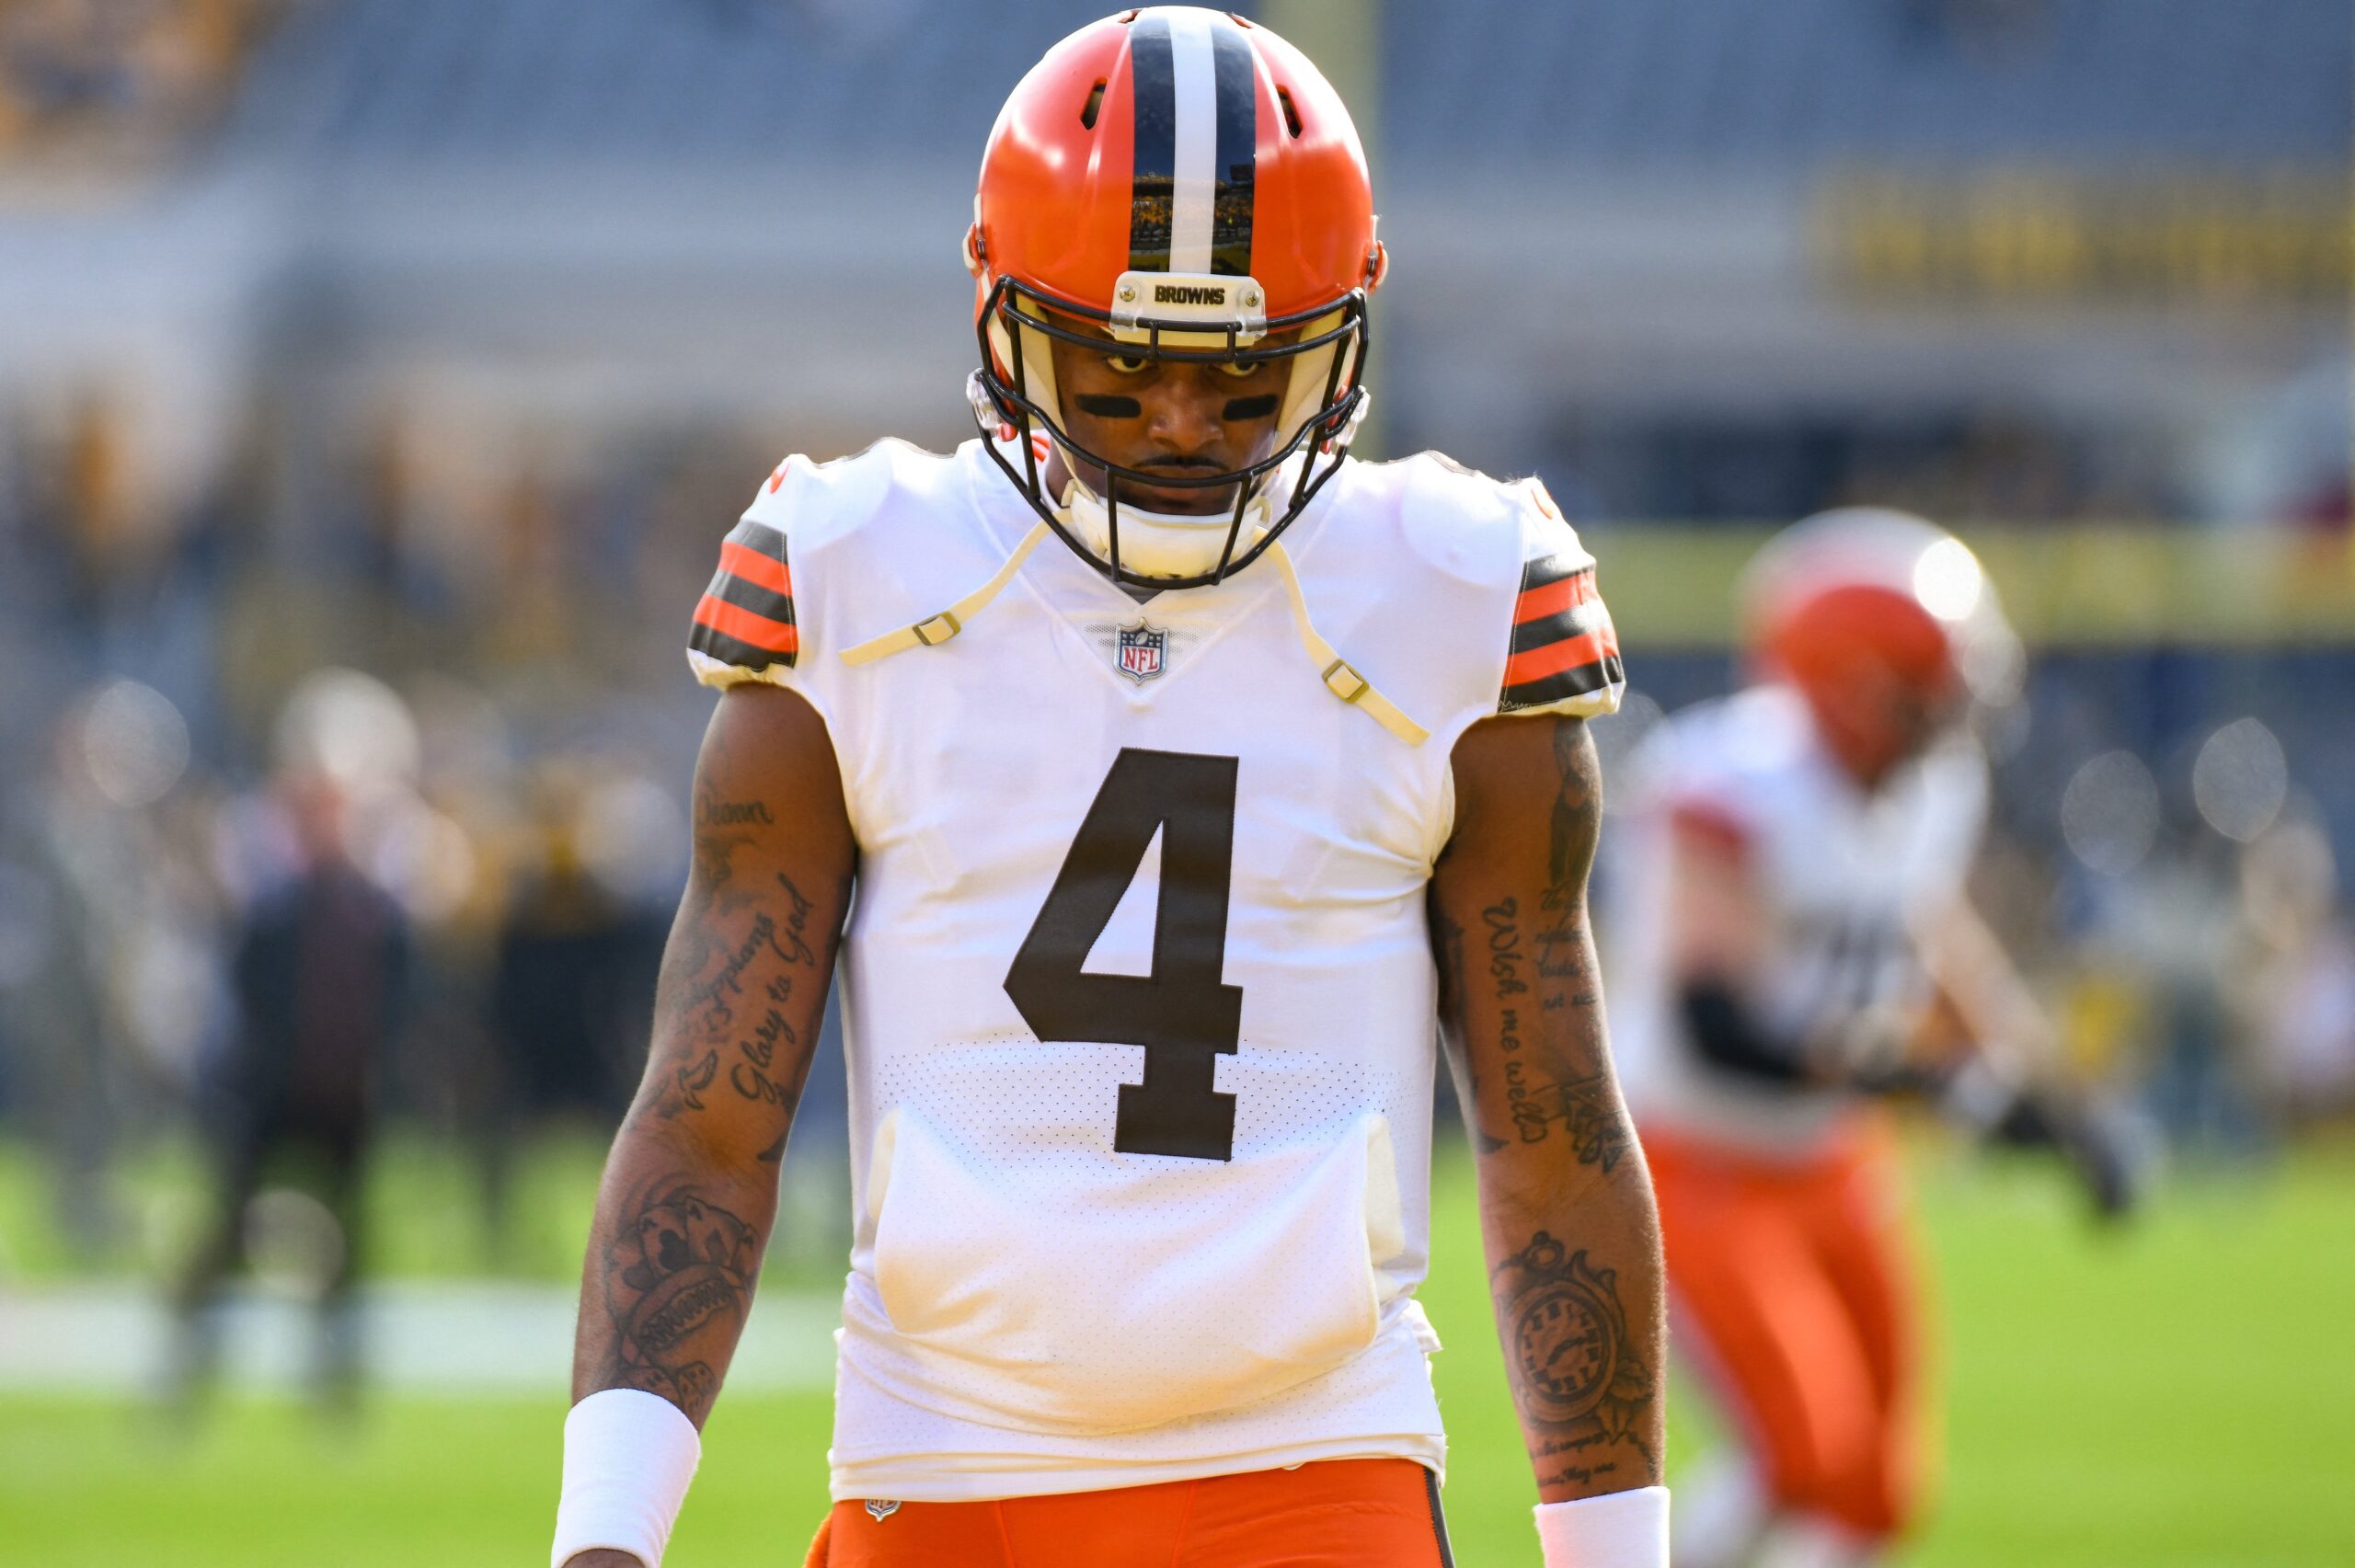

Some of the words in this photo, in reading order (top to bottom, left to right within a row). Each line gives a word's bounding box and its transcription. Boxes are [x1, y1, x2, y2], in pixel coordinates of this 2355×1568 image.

[1155, 284, 1225, 305] BROWNS
[1122, 647, 1159, 673] NFL
[771, 873, 815, 967] God
[1003, 747, 1244, 1162] 4
[1483, 897, 1528, 1001] Wish
[769, 975, 792, 1003] to
[730, 1010, 795, 1103] Glory
[1500, 1008, 1522, 1054] me
